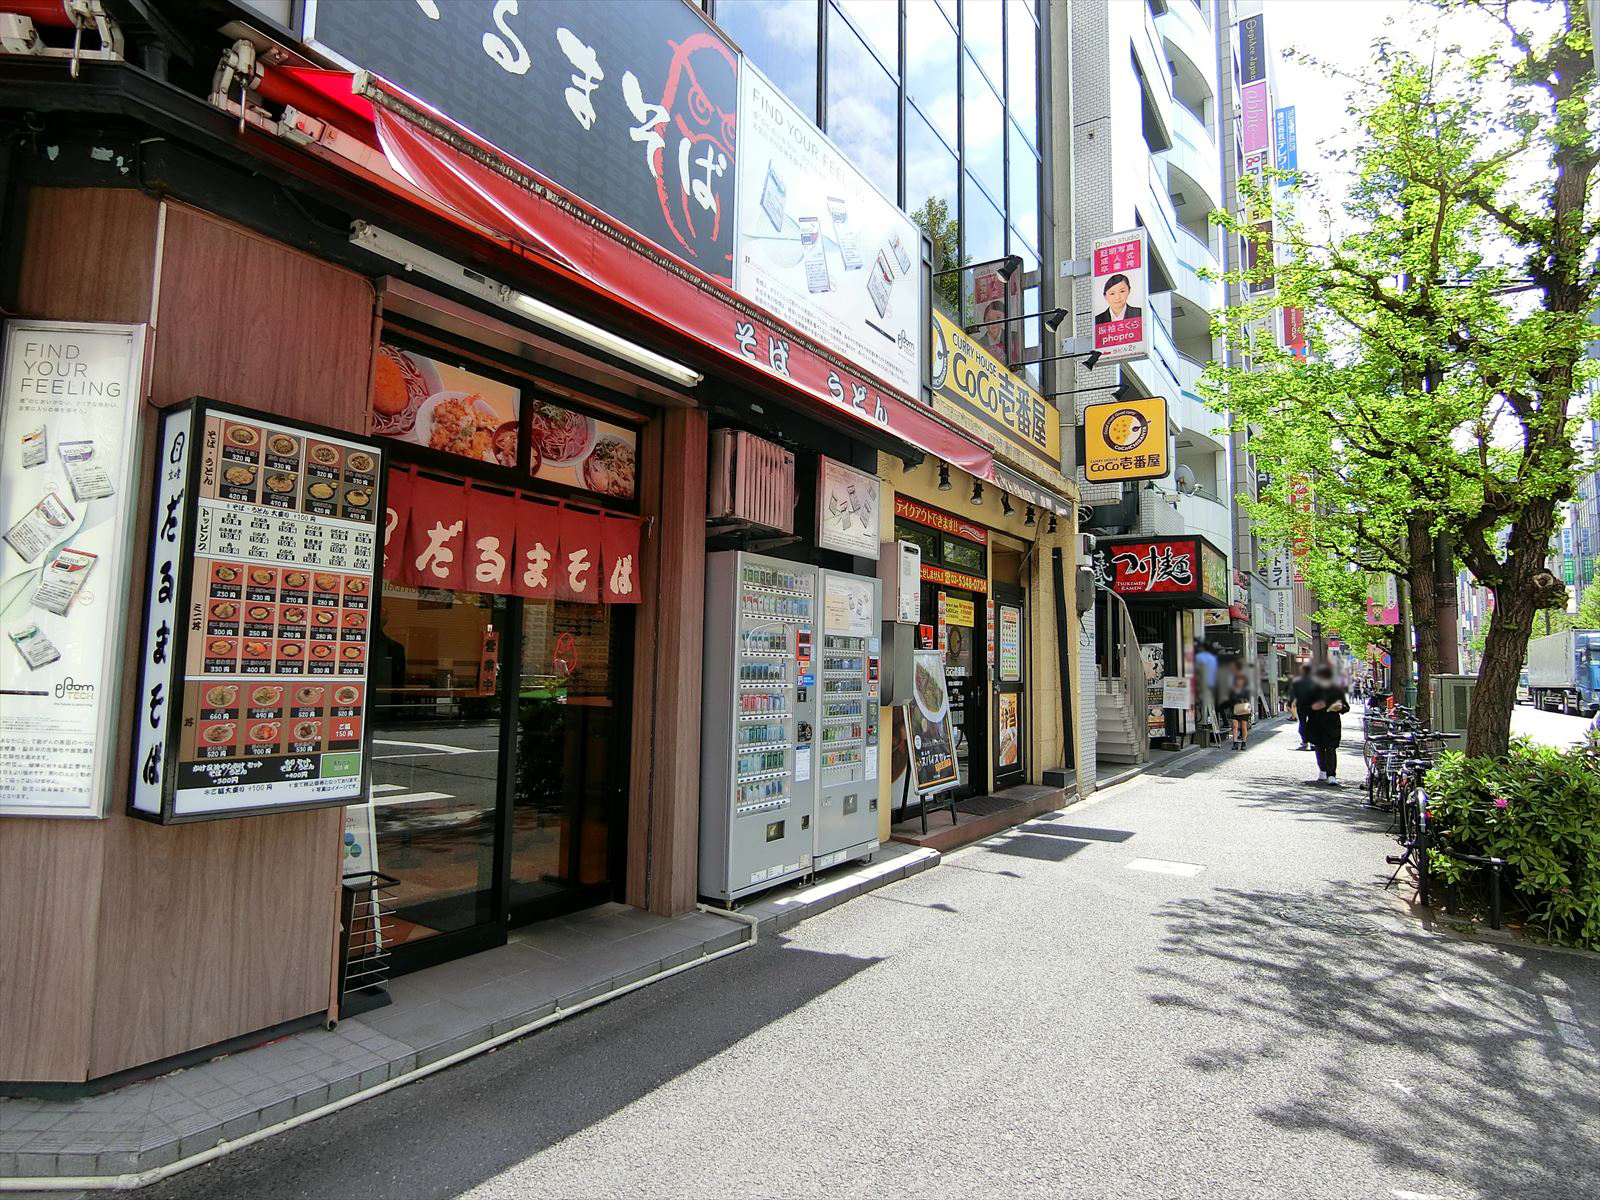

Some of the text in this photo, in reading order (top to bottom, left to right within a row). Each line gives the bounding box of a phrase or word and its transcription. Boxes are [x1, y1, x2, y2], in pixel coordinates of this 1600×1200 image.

[753, 87, 783, 126] FIND
[788, 119, 819, 161] YOUR
[735, 320, 791, 378] そば
[1098, 321, 1139, 335] 振袖さくら
[1102, 332, 1134, 345] phopro
[23, 360, 88, 377] YOUR
[25, 342, 80, 359] FIND
[952, 333, 997, 377] CURRY HOUSE
[20, 378, 121, 397] FEELING
[827, 370, 889, 426] うどん
[952, 351, 1047, 449] CoCo壱番屋
[204, 431, 217, 486] そば・うどん
[1090, 454, 1160, 472] CoCo壱番屋
[198, 508, 210, 551] トッピング
[896, 499, 958, 532] テイクアウトできます!!
[416, 520, 632, 594] だるまそば
[1112, 546, 1193, 591] つけ麺
[143, 488, 185, 786] だるまそば
[55, 677, 94, 698] ploom
[67, 691, 94, 700] TECH
